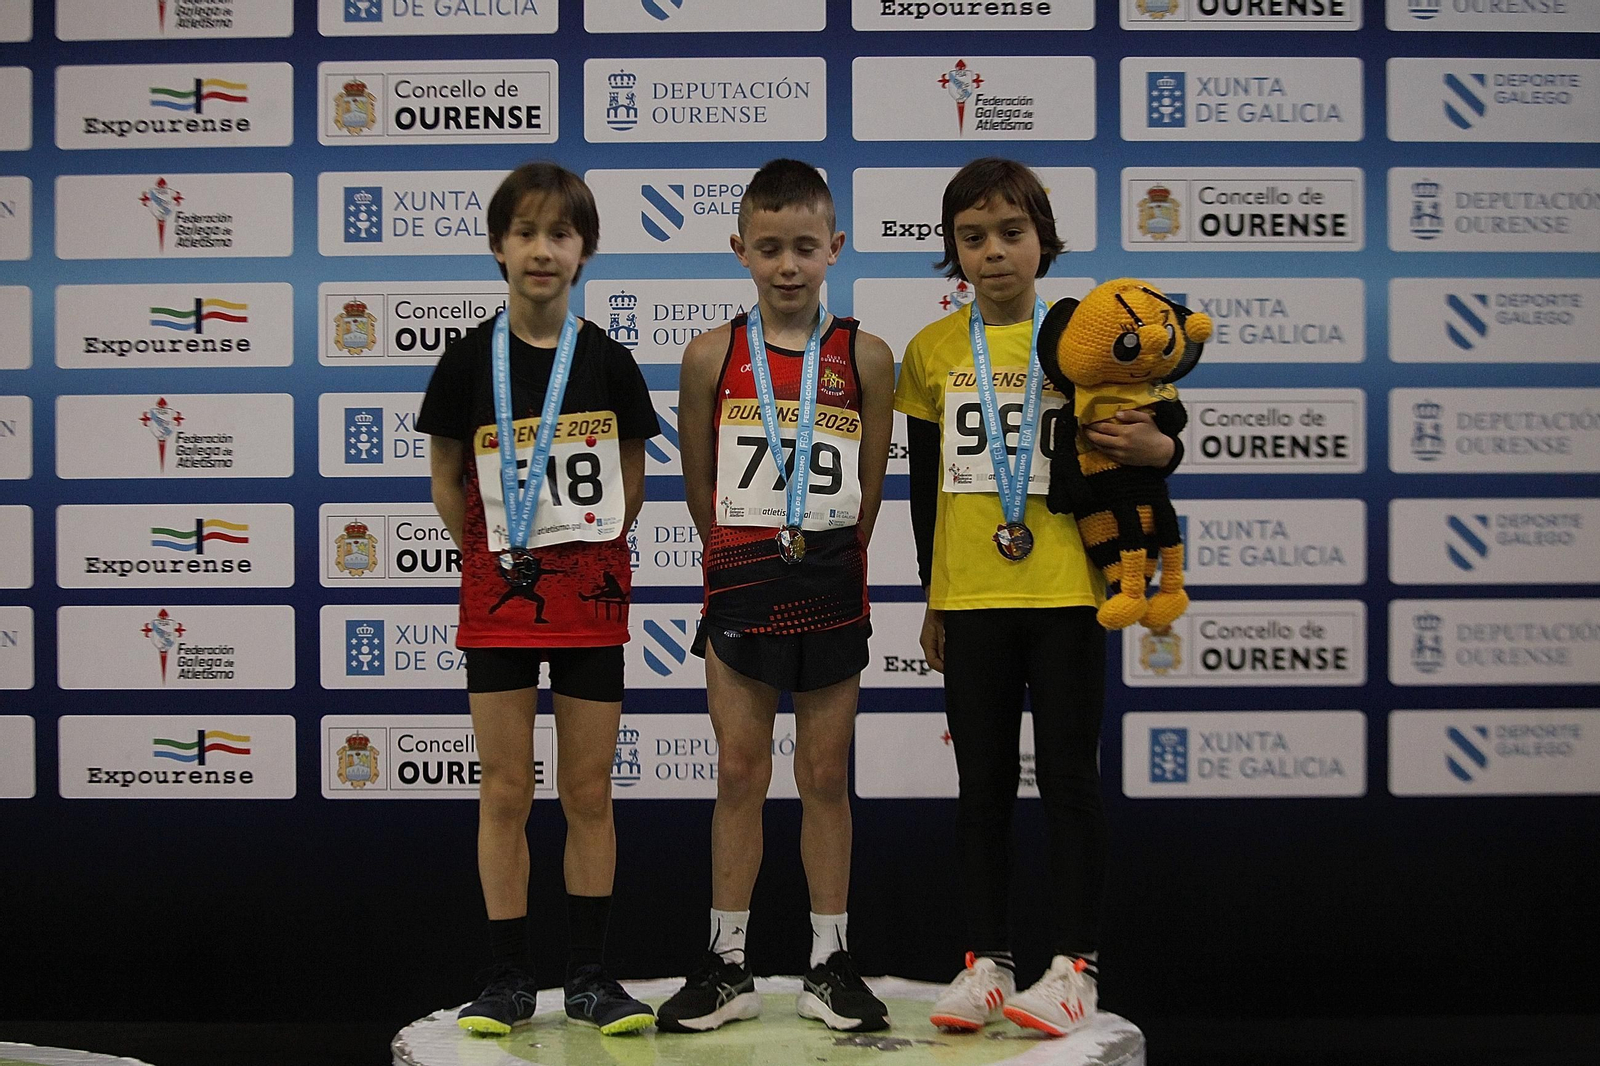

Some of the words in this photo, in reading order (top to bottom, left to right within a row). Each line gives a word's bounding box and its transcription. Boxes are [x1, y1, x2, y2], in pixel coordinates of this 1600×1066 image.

[393, 0, 424, 17] DE
[435, 0, 538, 16] GALICIA
[880, 0, 1051, 19] Expourense
[1199, 0, 1344, 17] OURENSE
[394, 79, 486, 99] Concello
[494, 79, 518, 97] de
[652, 77, 811, 100] DEPUTACIÓN
[1196, 77, 1287, 97] XUNTA
[1494, 74, 1581, 87] DEPORTE
[975, 94, 1034, 106] Federación
[1494, 91, 1571, 104] GALEGO
[395, 105, 541, 130] OURENSE
[652, 106, 767, 124] OURENSE
[975, 107, 1020, 121] Galega
[1022, 110, 1033, 119] de
[1195, 102, 1228, 123] DE
[1237, 102, 1344, 123] GALICIA
[83, 117, 251, 136] Expourense
[975, 120, 1034, 131] Atletismo
[393, 190, 482, 211] XUNTA
[693, 184, 749, 198] DEPO
[1198, 186, 1293, 205] Concello
[1298, 186, 1324, 205] de
[175, 211, 232, 223] Federación
[693, 202, 740, 215] GALE
[393, 217, 424, 237] DE
[1201, 213, 1347, 237] OURENSE
[1454, 216, 1570, 234] OURENSE
[395, 301, 486, 319] Concello
[495, 301, 507, 315] d
[653, 303, 746, 321] DEPUTA
[1198, 298, 1288, 318] XUNTA
[1239, 324, 1345, 344] GALICIA
[83, 337, 251, 357] Expourense
[953, 372, 1027, 388] OUENS
[758, 366, 769, 394] GALEGA
[765, 405, 777, 442] ATLETISMO
[727, 405, 800, 422] OURNS
[814, 412, 860, 433] 2025
[1200, 408, 1292, 427] Concello
[1300, 408, 1325, 427] de
[567, 418, 613, 437] 2025
[175, 431, 233, 444] Federación
[800, 431, 809, 448] FGA
[1021, 429, 1032, 446] FGA
[1202, 435, 1349, 458] OURENSE
[175, 444, 221, 457] Galega
[394, 439, 425, 458] DE
[175, 457, 233, 468] Atletismo
[737, 436, 842, 495] 779
[797, 456, 806, 495] ATLETISMO
[1016, 454, 1027, 495] ATLETISMO
[999, 467, 1011, 502] TLETISMO
[795, 496, 801, 506] DE
[396, 522, 450, 541] Conc
[1199, 520, 1289, 540] XUNTA
[1198, 546, 1230, 567] DE
[1239, 546, 1346, 567] GALICIA
[85, 557, 252, 577] Expourense
[396, 625, 457, 645] XUN
[1200, 620, 1293, 640] Concello
[1299, 620, 1325, 639] de
[177, 643, 234, 655] Federación
[177, 656, 222, 669] Galega
[224, 659, 234, 668] de
[395, 651, 426, 671] DE
[1202, 648, 1348, 671] OURENSE
[177, 668, 234, 680] Atletismo
[397, 734, 475, 753] Concell
[1198, 731, 1291, 752] XUNTA
[87, 767, 253, 787] Expourense
[398, 761, 544, 784] OUREE
[656, 763, 718, 780] OURE
[1198, 757, 1232, 779] DE
[1239, 757, 1345, 779] GALICIA
